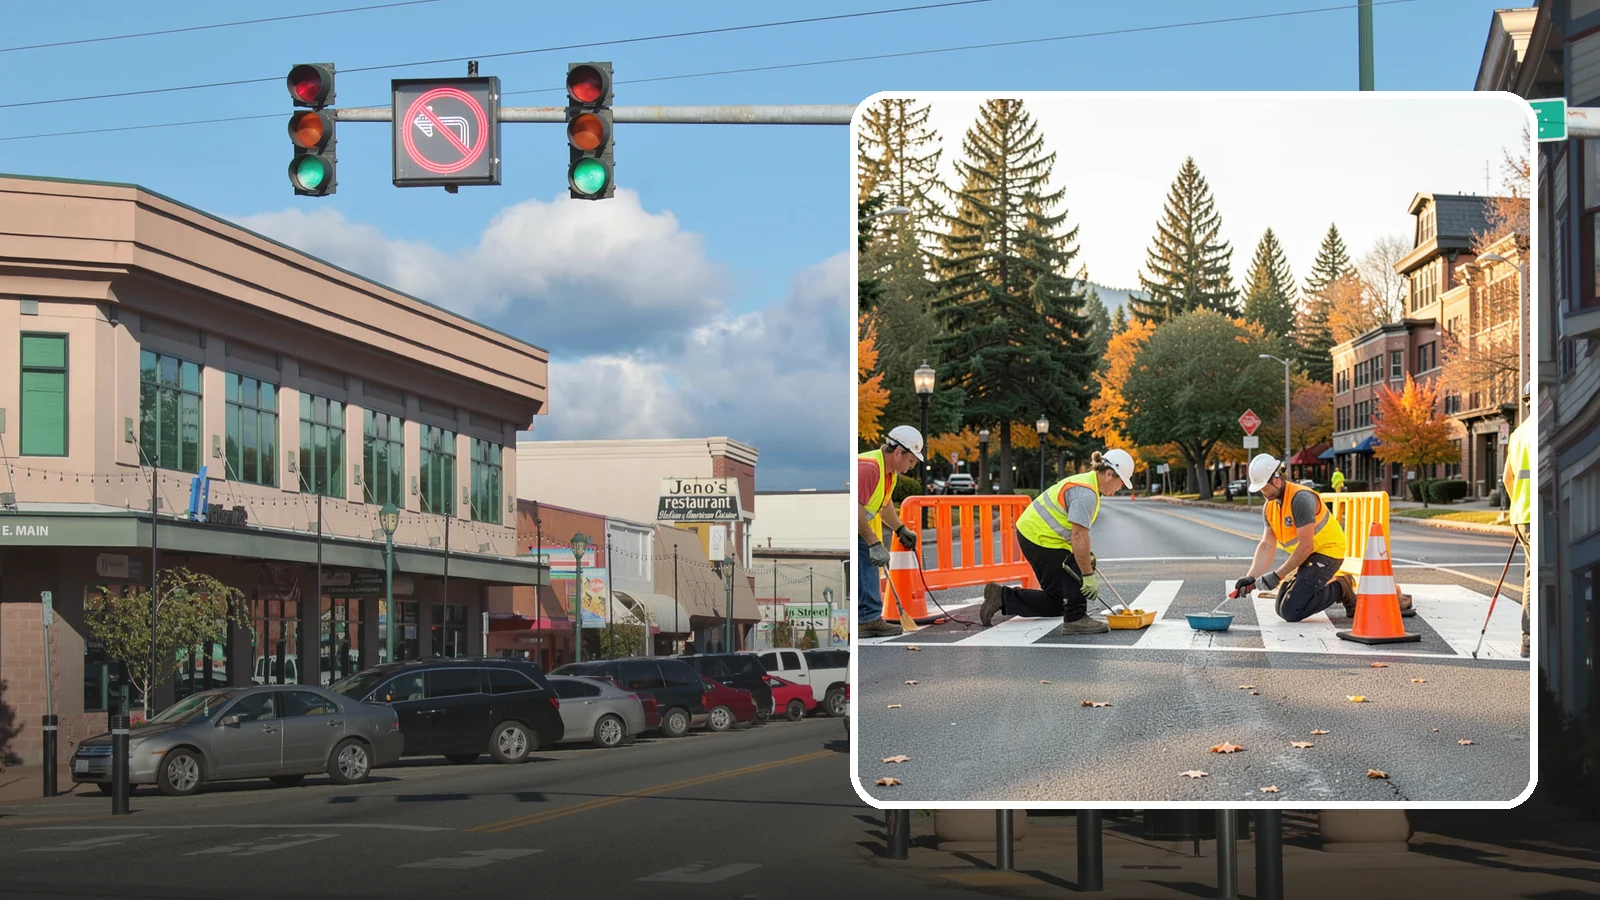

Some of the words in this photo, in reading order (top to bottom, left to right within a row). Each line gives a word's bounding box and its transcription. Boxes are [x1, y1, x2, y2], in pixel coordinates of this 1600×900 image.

[670, 480, 727, 494] Jeno's
[665, 496, 731, 509] restaurant
[658, 509, 682, 519] Italian
[686, 509, 714, 519] American
[715, 509, 738, 519] Cuisine
[2, 525, 13, 536] E.
[15, 525, 49, 536] MAIN
[797, 607, 828, 617] Street
[790, 619, 823, 627] lass
